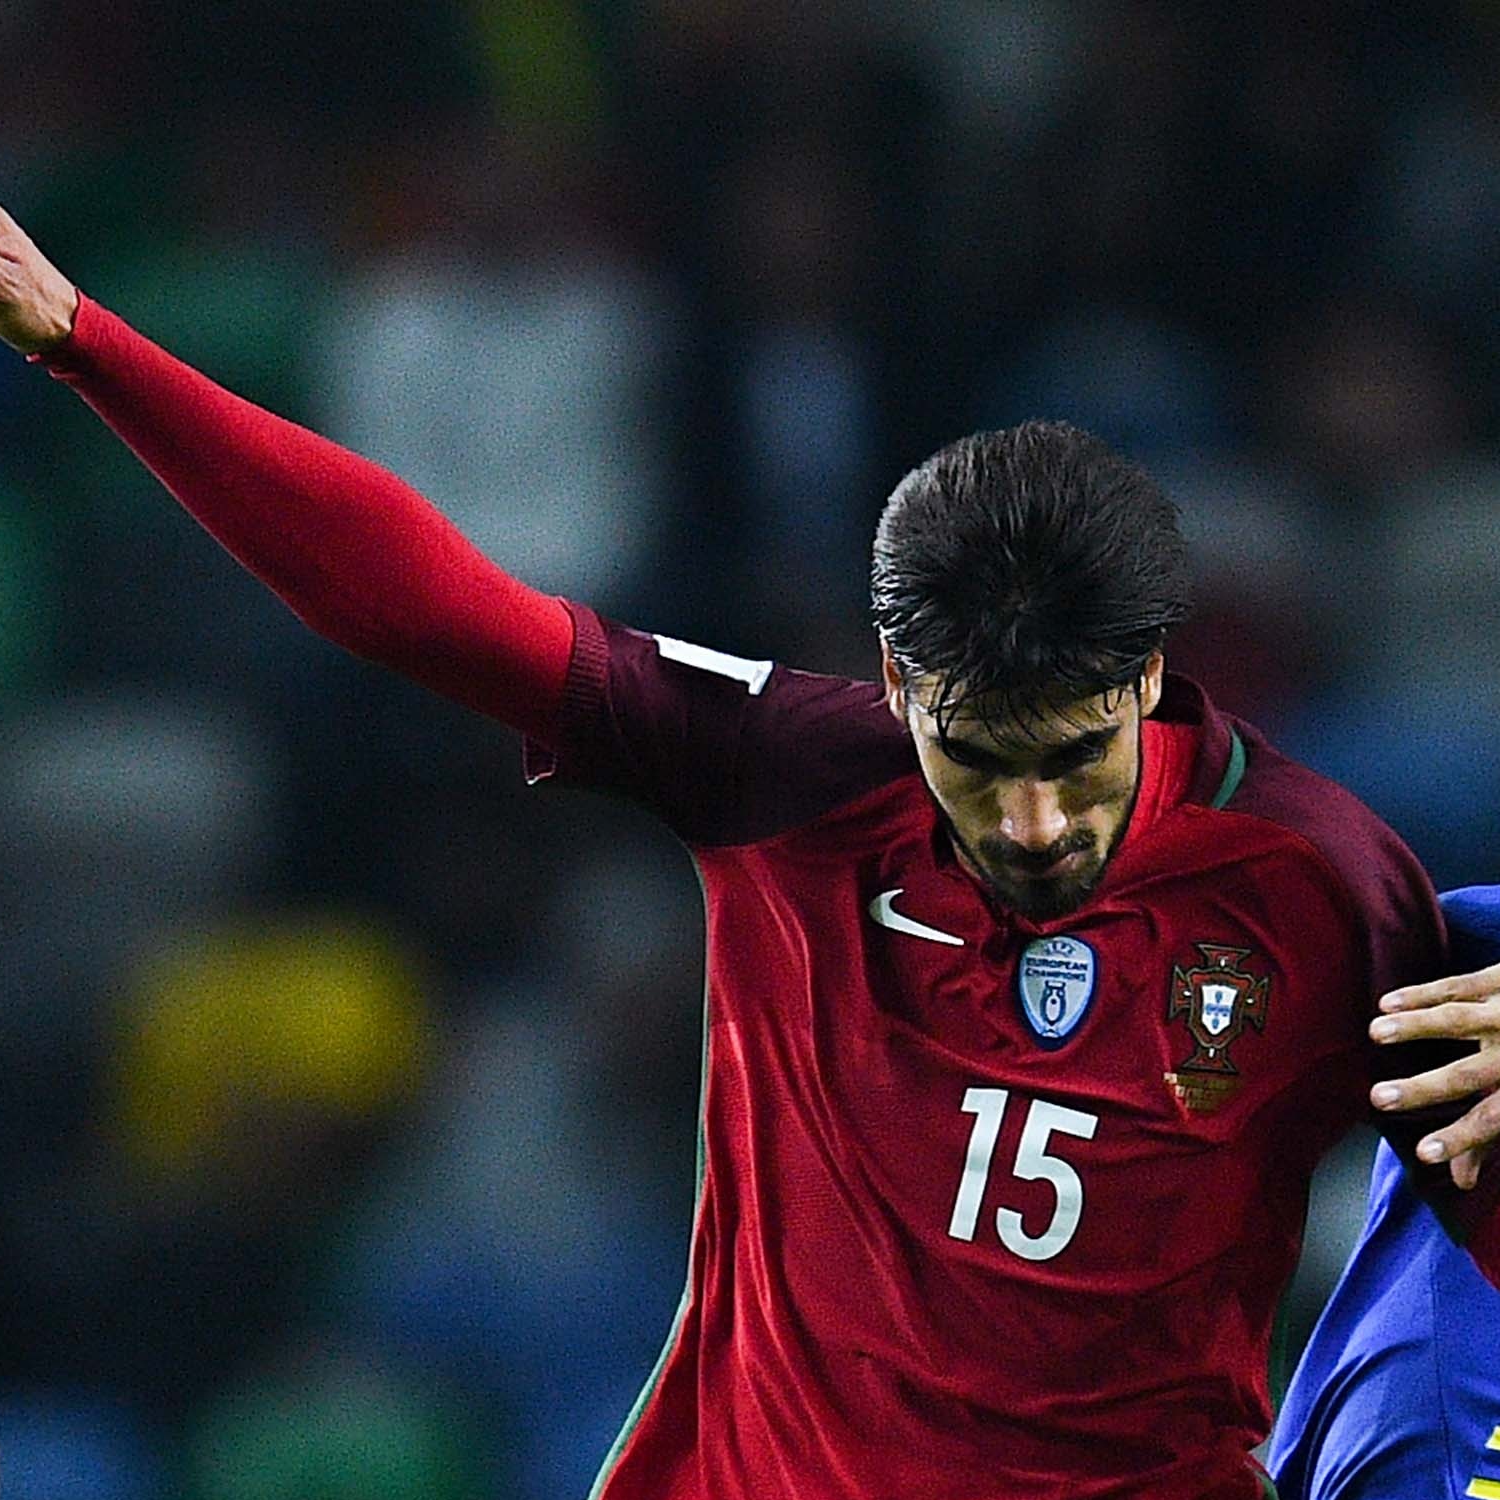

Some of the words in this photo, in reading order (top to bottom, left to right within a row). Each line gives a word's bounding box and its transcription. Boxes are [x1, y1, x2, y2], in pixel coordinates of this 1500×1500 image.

[1026, 957, 1088, 970] EUROPEAN
[1026, 968, 1086, 982] CHAMPIONS
[947, 1086, 1099, 1263] 15
